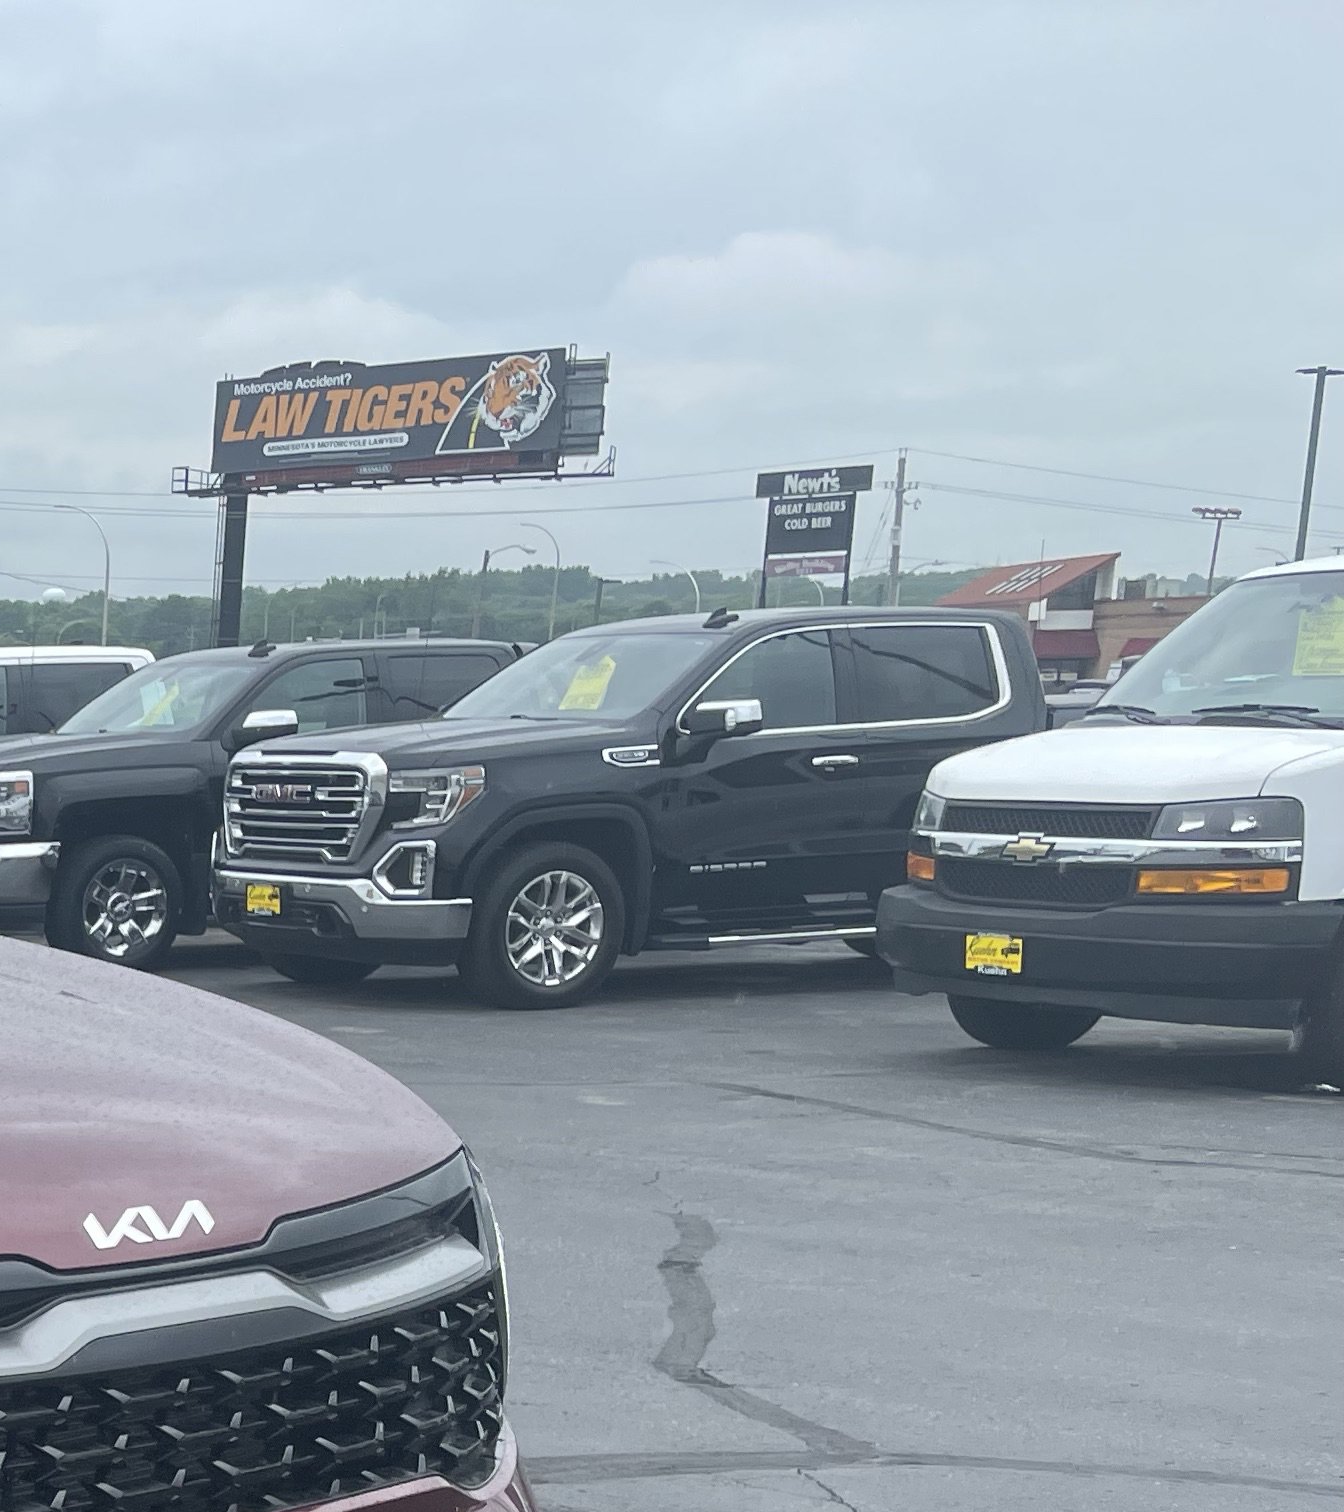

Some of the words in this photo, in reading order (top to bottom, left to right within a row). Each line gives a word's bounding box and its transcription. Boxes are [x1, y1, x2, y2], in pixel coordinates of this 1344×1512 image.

[234, 379, 292, 397] Motorcycle
[295, 372, 352, 390] Accident?
[221, 391, 320, 443] LAW
[324, 376, 466, 434] TIGERS
[783, 469, 841, 494] Newt's
[774, 502, 802, 516] GREAT
[805, 500, 846, 514] BURGERS
[784, 517, 808, 530] COLD
[811, 516, 832, 529] BEER
[255, 784, 311, 803] GMC
[82, 1199, 216, 1250] KIA
